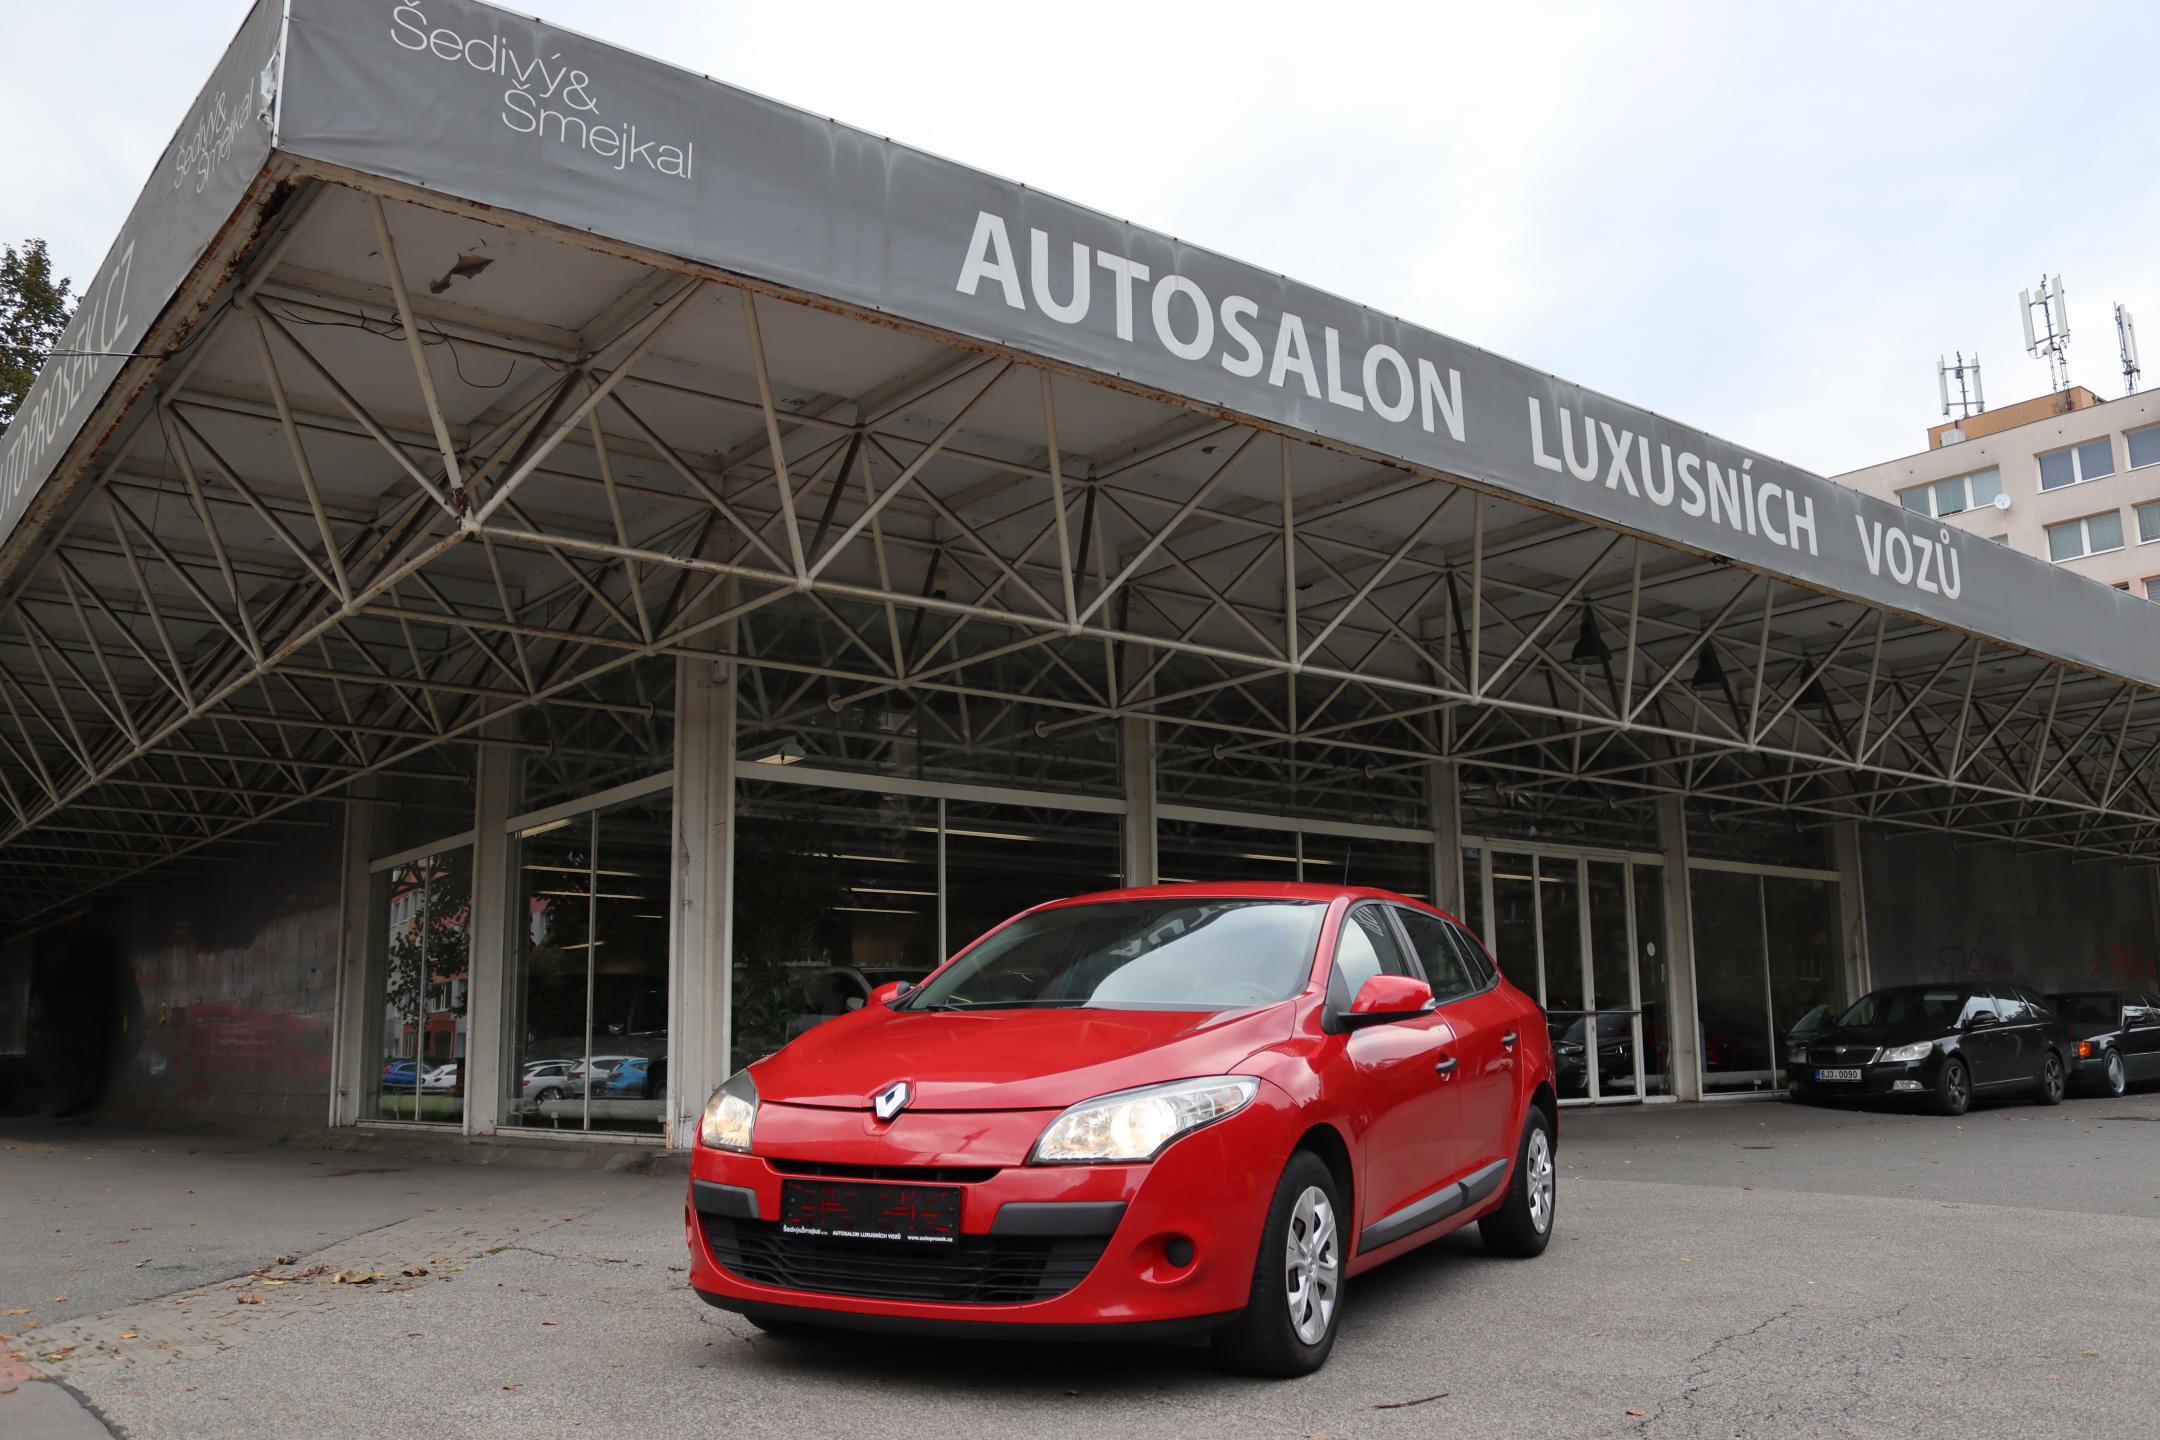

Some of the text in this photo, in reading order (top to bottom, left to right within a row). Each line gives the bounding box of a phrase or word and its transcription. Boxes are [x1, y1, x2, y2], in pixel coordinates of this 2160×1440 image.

[390, 0, 600, 114] Šedivý&
[502, 78, 693, 179] Šmejkal
[955, 210, 1961, 600] AUTOSALON LUXUSNÍCH VOZŮ
[832, 1230, 859, 1238] AUTOSALON
